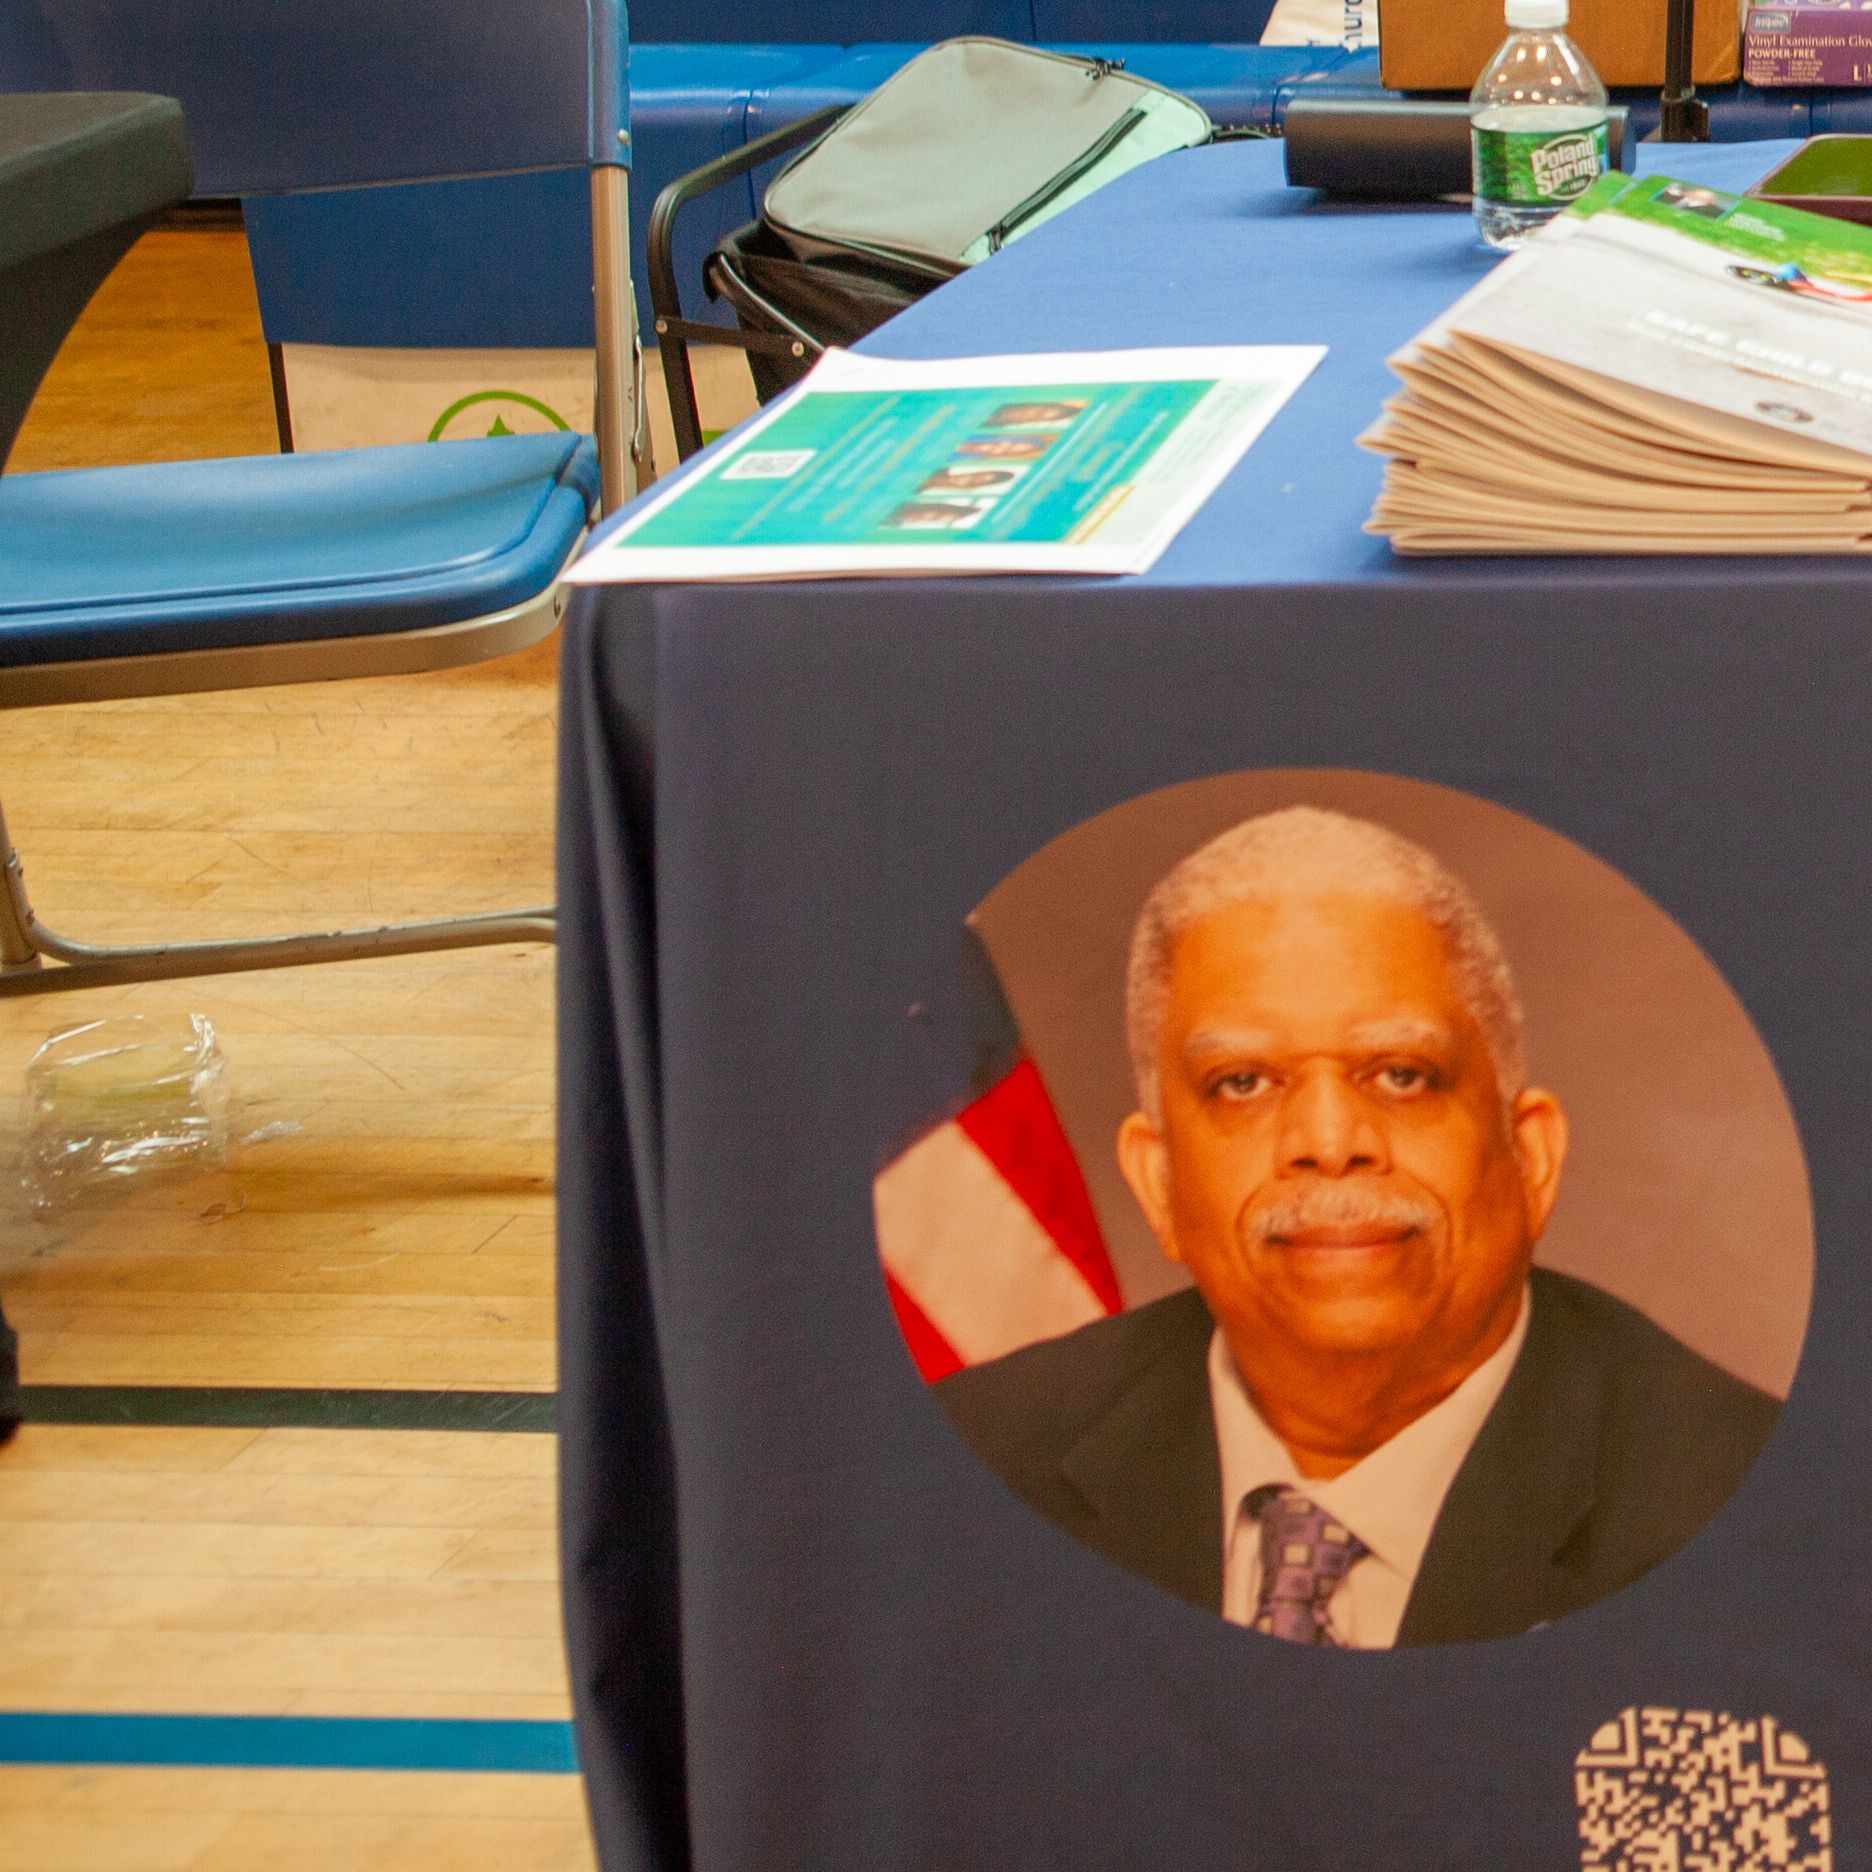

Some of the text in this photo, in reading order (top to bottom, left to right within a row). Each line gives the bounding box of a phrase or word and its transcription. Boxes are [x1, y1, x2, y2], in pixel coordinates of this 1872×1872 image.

[1750, 35, 1776, 48] Vinyl
[1780, 35, 1845, 47] Examination
[1749, 48, 1816, 59] POWDER-FREE
[1853, 65, 1862, 81] L
[1530, 131, 1597, 175] Poland
[1535, 155, 1600, 196] Spring
